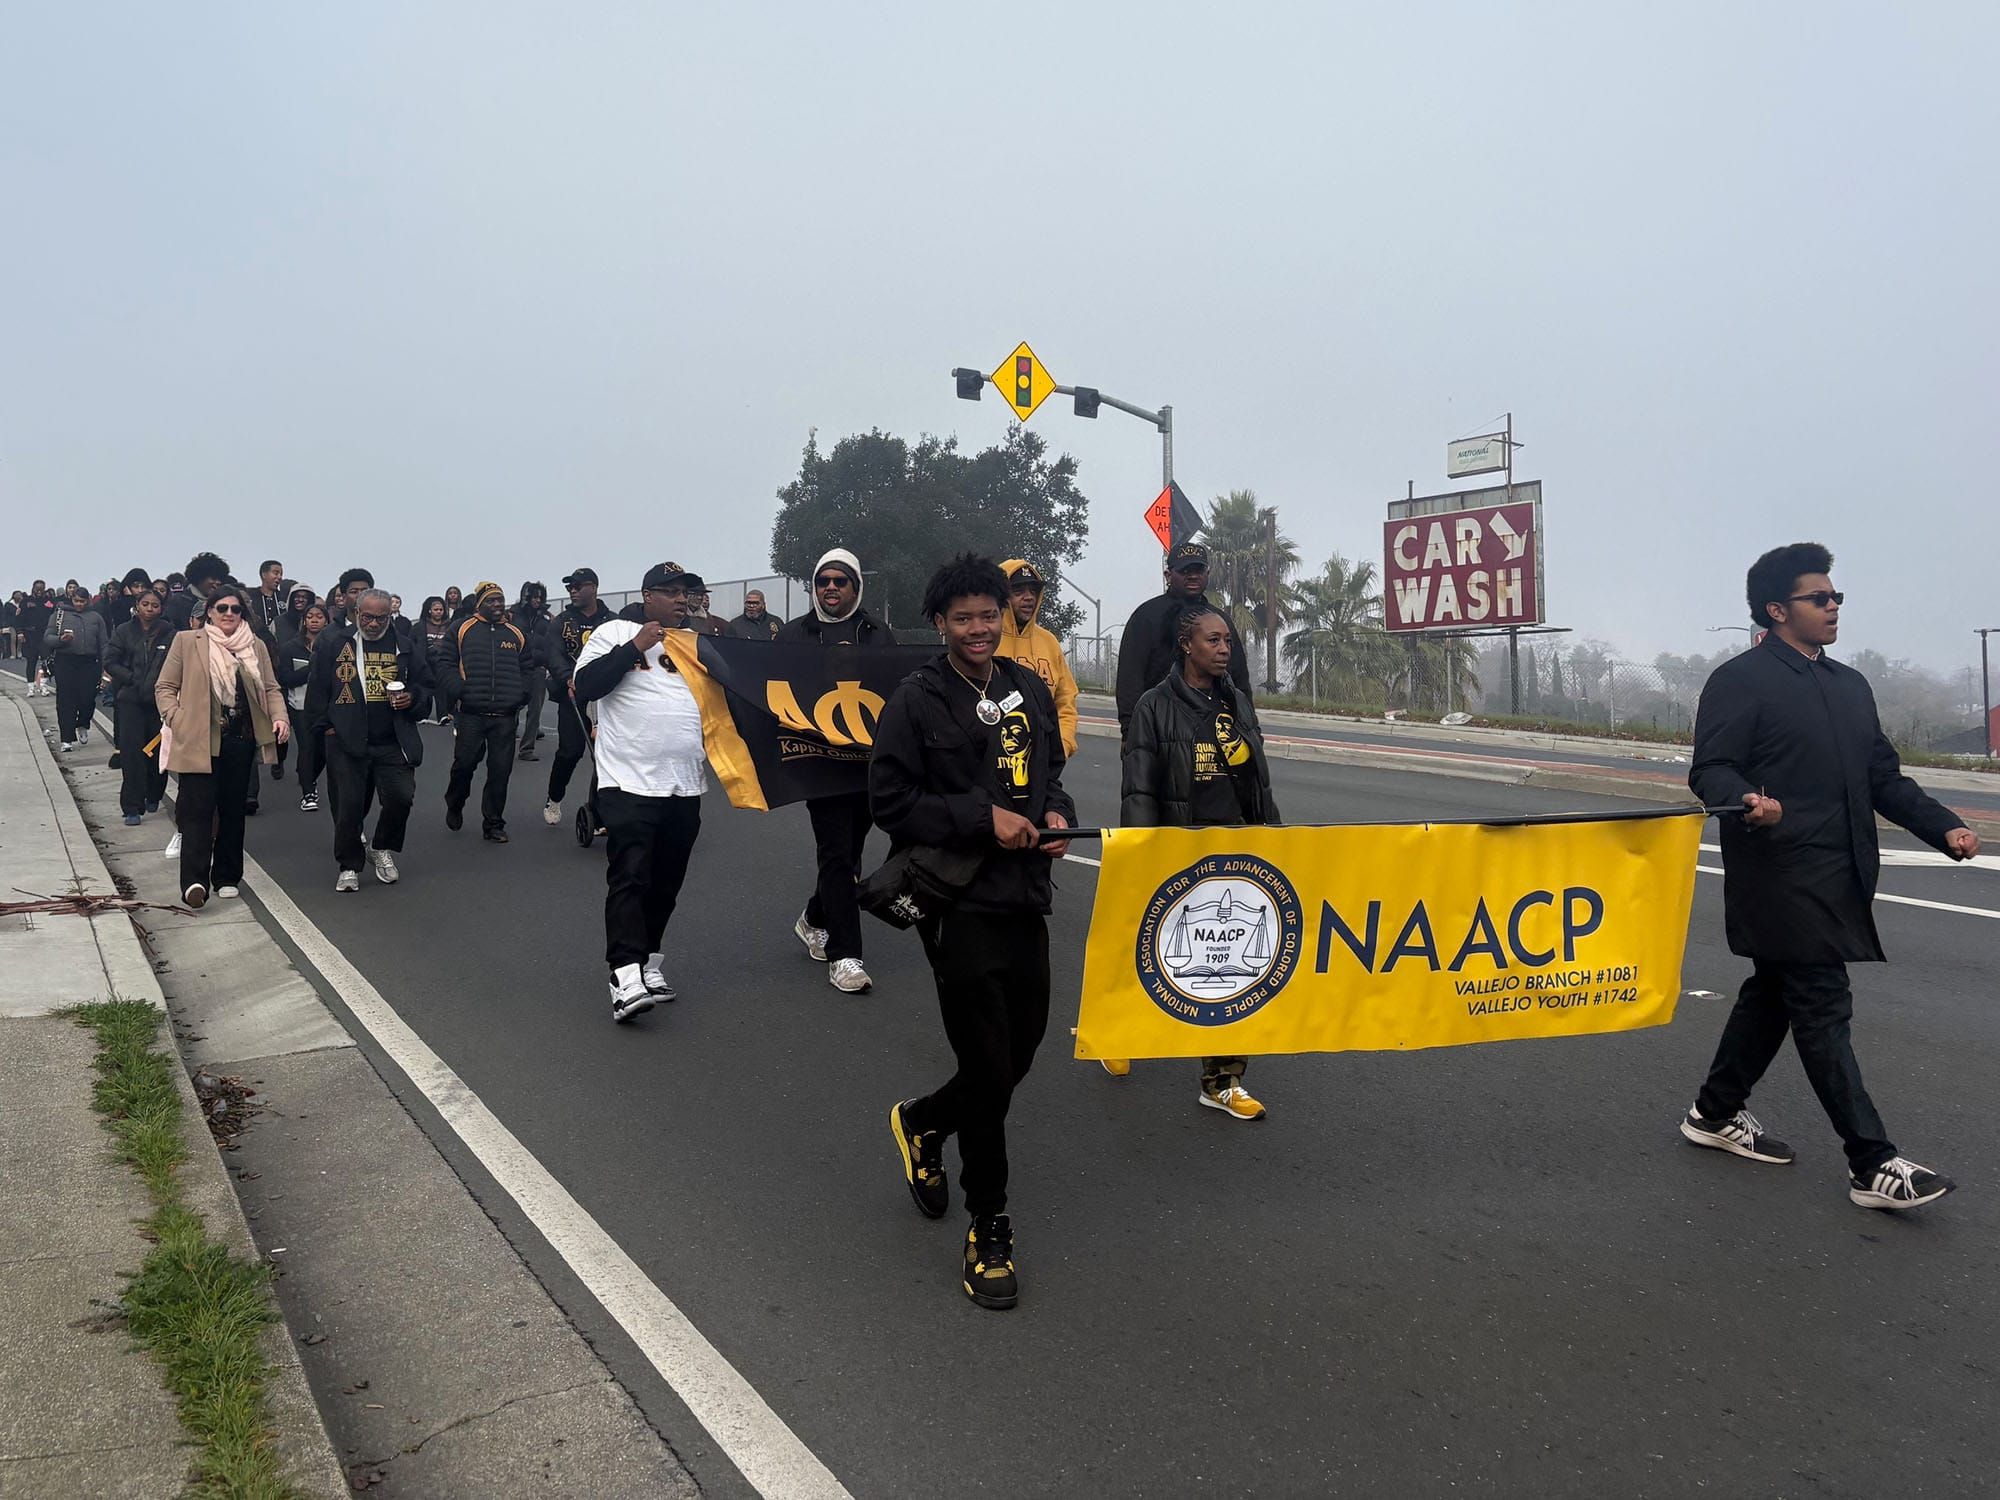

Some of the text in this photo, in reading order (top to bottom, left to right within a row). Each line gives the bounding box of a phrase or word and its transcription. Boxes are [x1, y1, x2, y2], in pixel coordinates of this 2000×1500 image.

[1393, 517, 1483, 571] CAR
[1392, 567, 1523, 624] WASH
[780, 740, 823, 755] Kappa
[1141, 860, 1297, 1018] NATIONAL ASSOCIATION FOR THE ADVANCEMENT OF COLORED PEOPLE
[1194, 928, 1246, 943] NAACP
[1314, 886, 1605, 975] NAACP
[1205, 953, 1230, 964] 1909
[1455, 965, 1639, 996] VALLEJO BRANCH #1081
[1467, 988, 1638, 1016] VALLEJO YOUTH #1742
